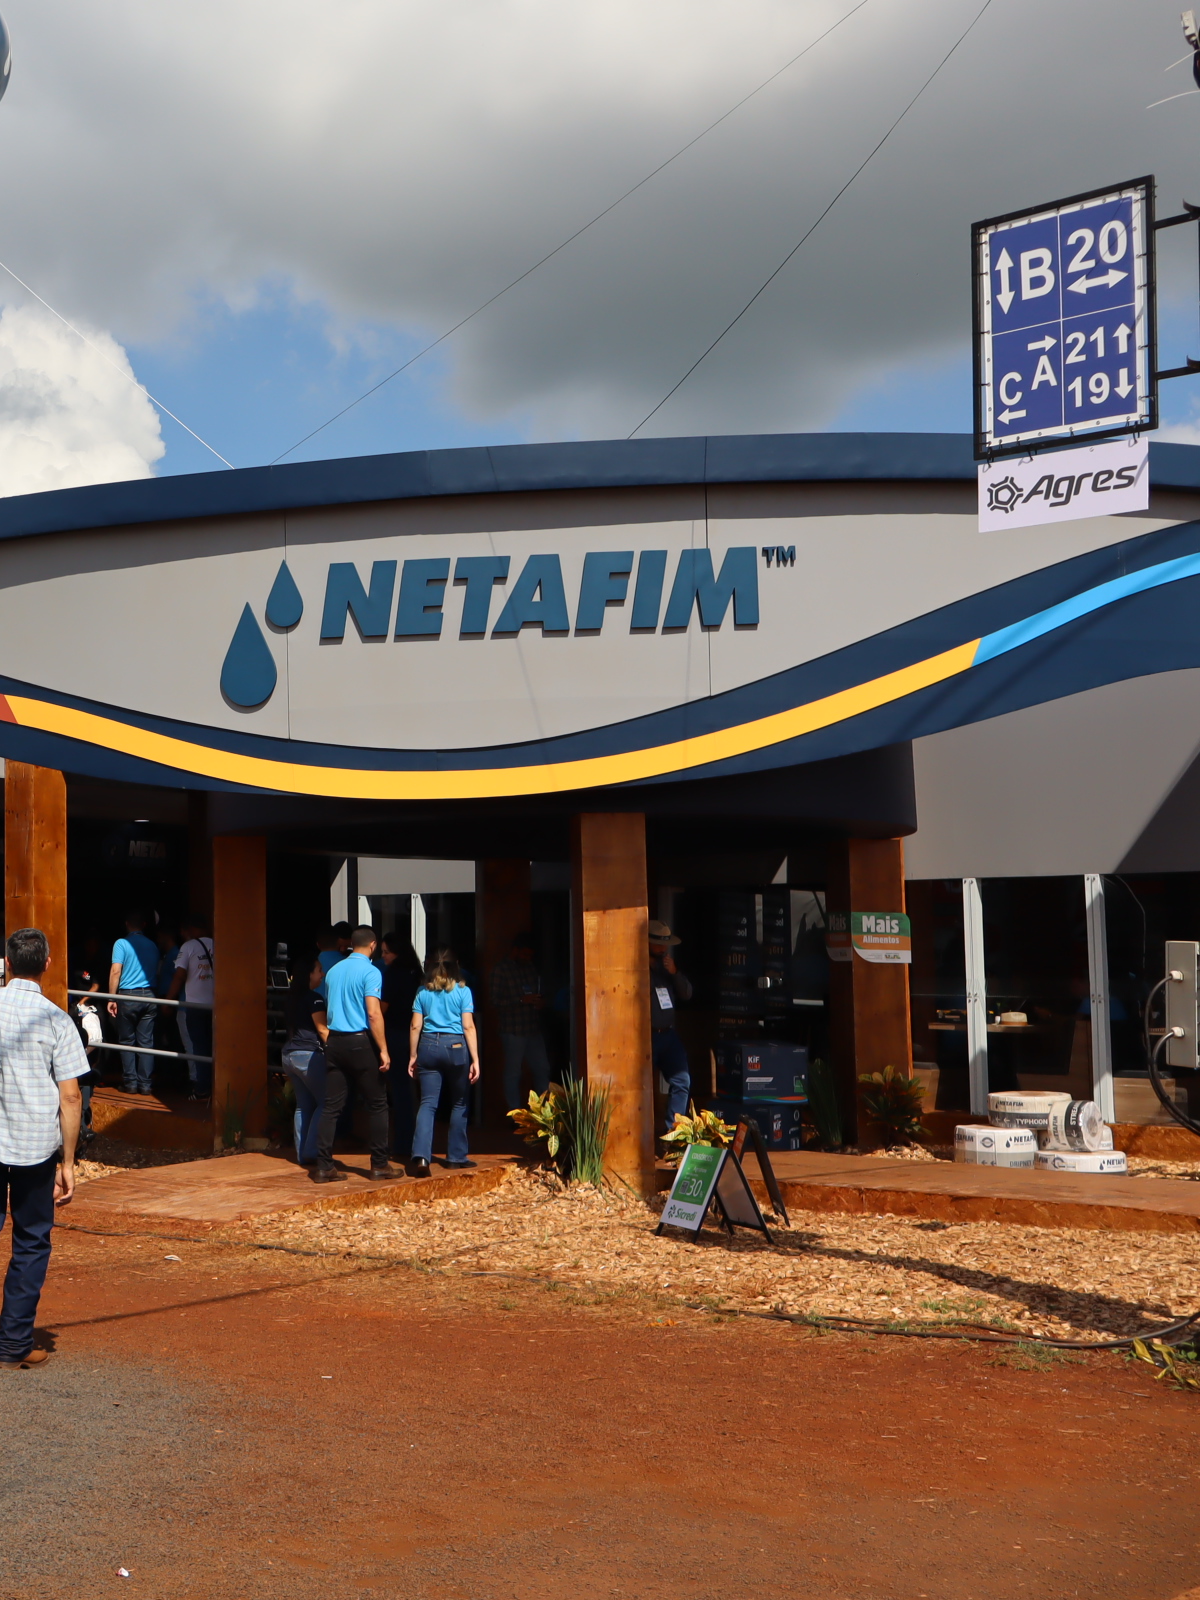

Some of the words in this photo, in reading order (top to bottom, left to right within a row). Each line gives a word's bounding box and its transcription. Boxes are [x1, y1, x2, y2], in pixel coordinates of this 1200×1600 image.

[1067, 218, 1128, 274] 20
[1020, 247, 1055, 300] B
[1065, 326, 1106, 365] 21
[999, 371, 1023, 406] C
[1031, 353, 1057, 390] A
[1067, 376, 1110, 407] 19
[1021, 464, 1137, 508] Agres
[862, 915, 900, 934] Mais
[862, 936, 900, 944] Alimentos
[686, 1178, 703, 1197] 30
[675, 1208, 698, 1222] Sicredi
